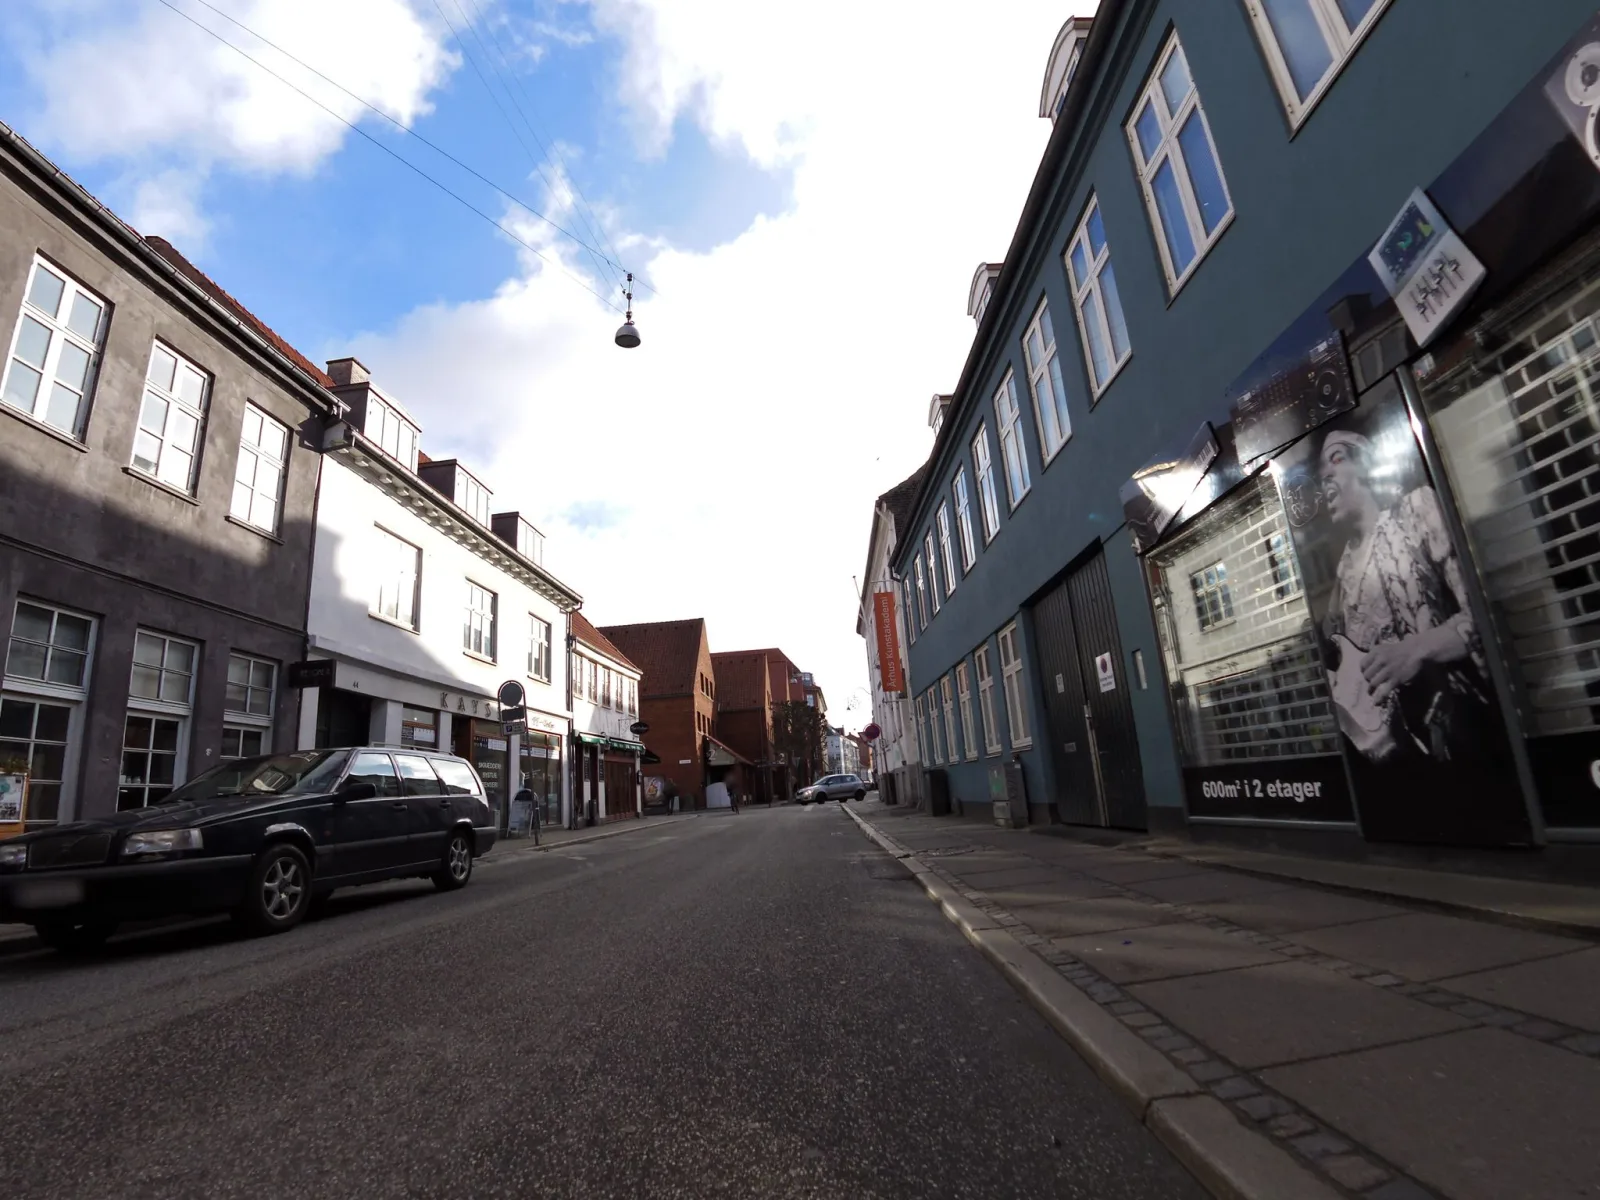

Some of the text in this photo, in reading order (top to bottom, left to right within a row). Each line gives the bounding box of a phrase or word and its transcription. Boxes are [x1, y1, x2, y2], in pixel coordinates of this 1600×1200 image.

[881, 597, 897, 688] Århus Kunstakademi
[440, 692, 500, 719] KAYS
[1202, 778, 1322, 803] 600m² i 2 etager
